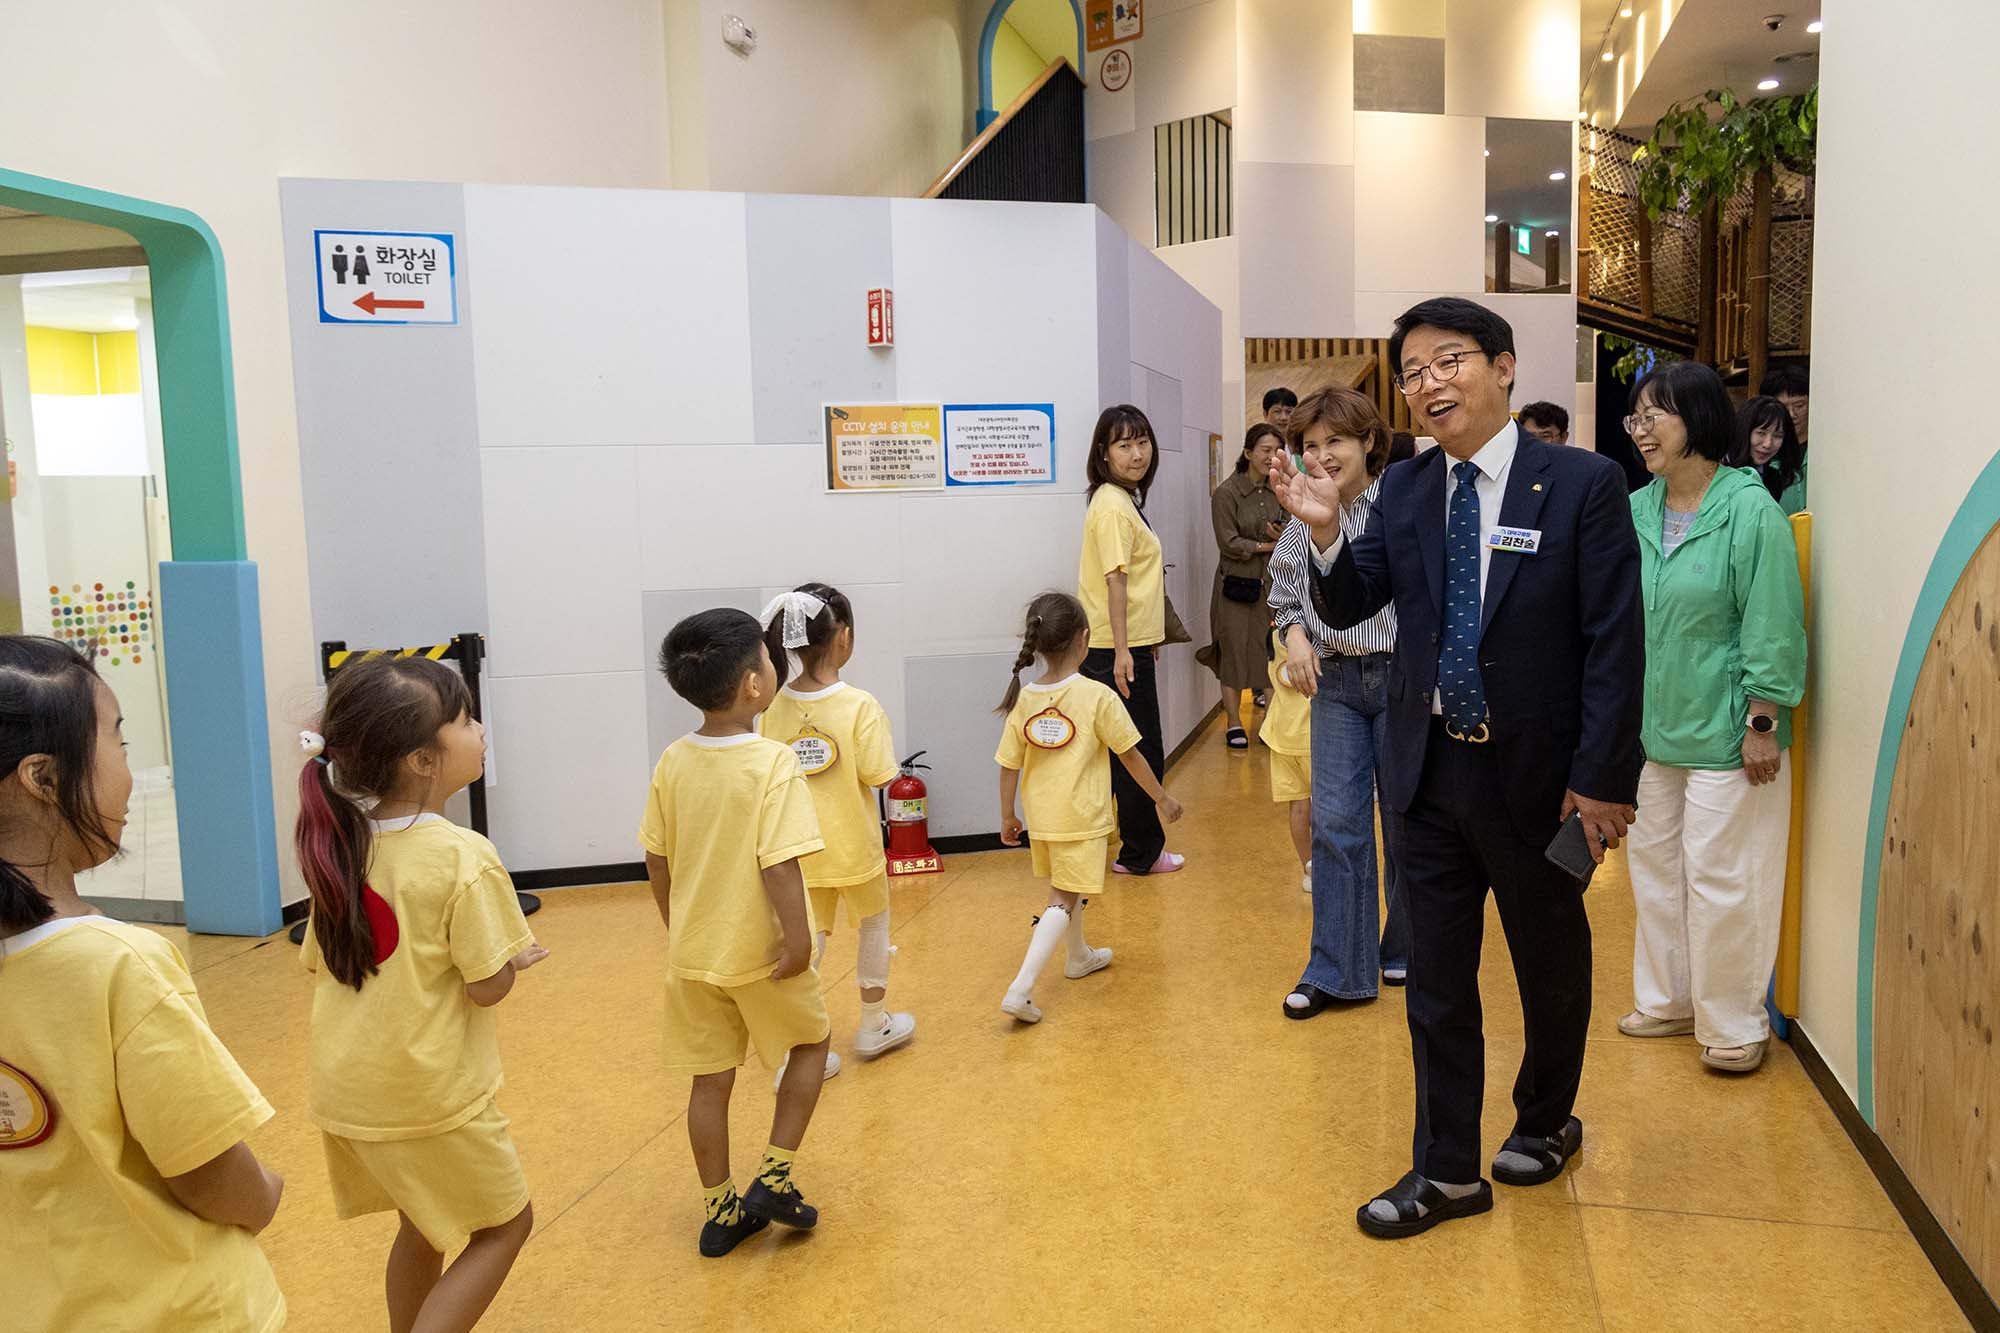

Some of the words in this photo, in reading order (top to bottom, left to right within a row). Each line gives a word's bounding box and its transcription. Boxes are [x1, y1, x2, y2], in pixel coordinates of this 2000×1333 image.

[376, 246, 436, 271] 화장실
[384, 272, 431, 284] TOILET
[842, 422, 866, 432] CCTV
[868, 421, 887, 434] 설치
[890, 421, 908, 433] 운영
[911, 420, 930, 432] 안내
[1502, 536, 1536, 549] 김찬술
[904, 858, 938, 870] 소화기
